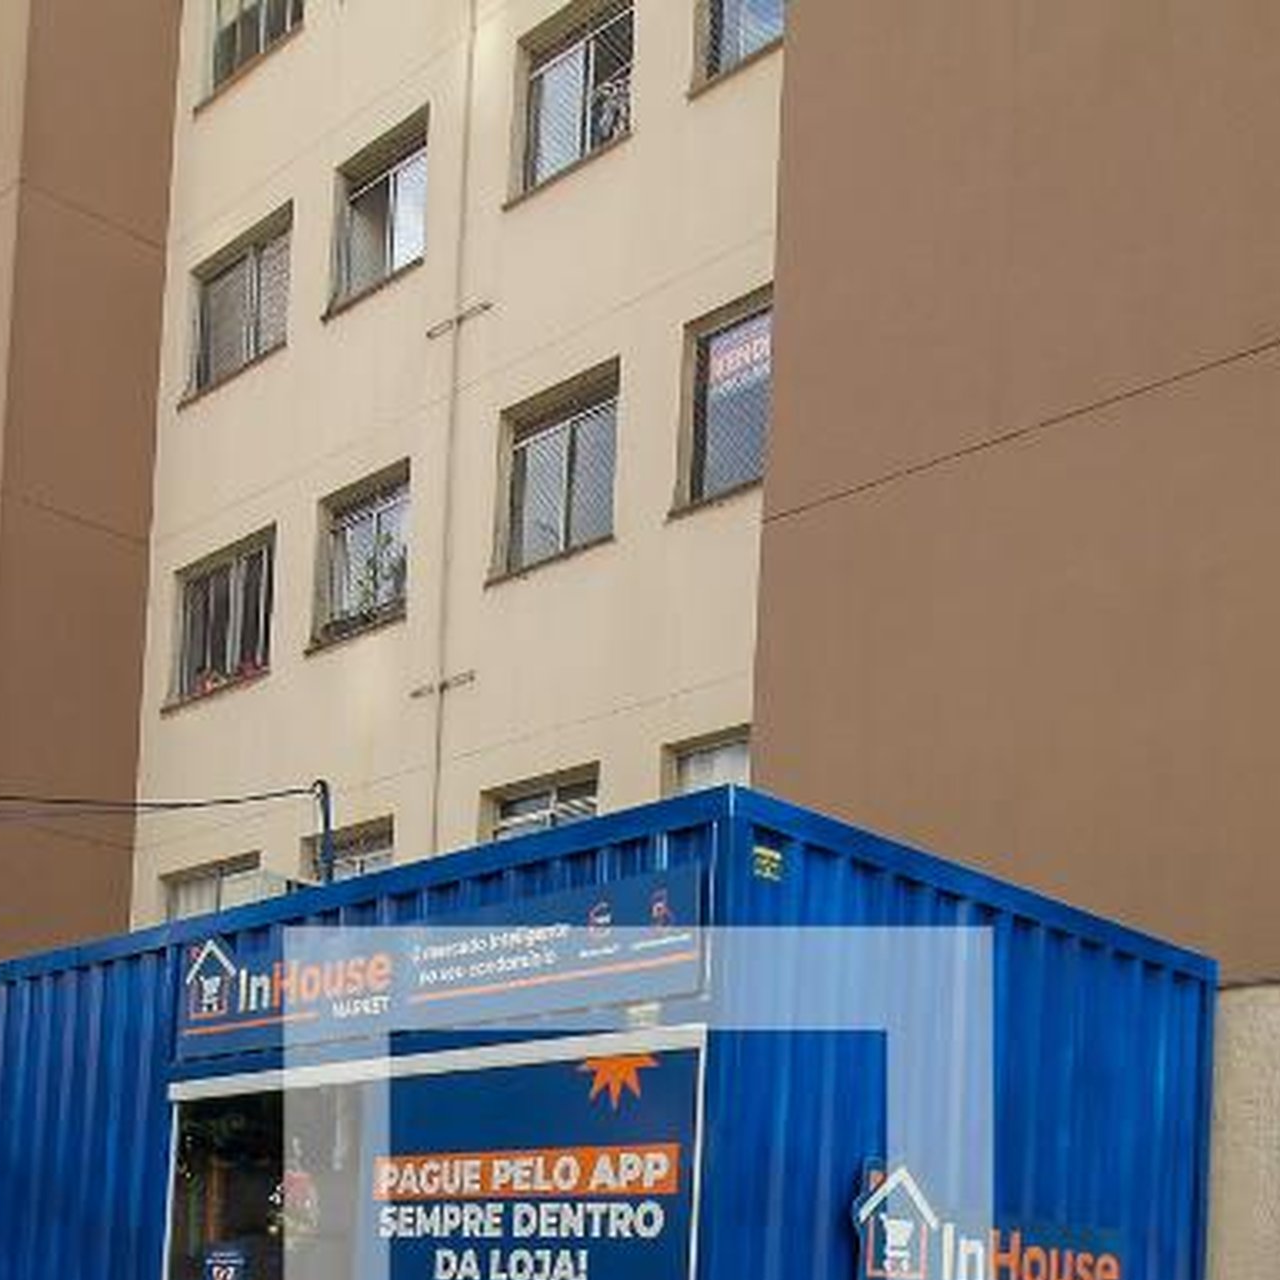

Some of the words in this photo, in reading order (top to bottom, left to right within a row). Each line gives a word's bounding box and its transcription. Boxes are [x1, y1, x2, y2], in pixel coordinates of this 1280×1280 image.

[239, 950, 392, 1013] InHouse
[332, 996, 390, 1018] MARKET
[378, 1159, 480, 1195] PAGUE
[492, 1156, 581, 1192] PELO
[589, 1151, 670, 1189] APP
[378, 1203, 504, 1238] SEMPRE
[512, 1201, 665, 1238] DENTRO
